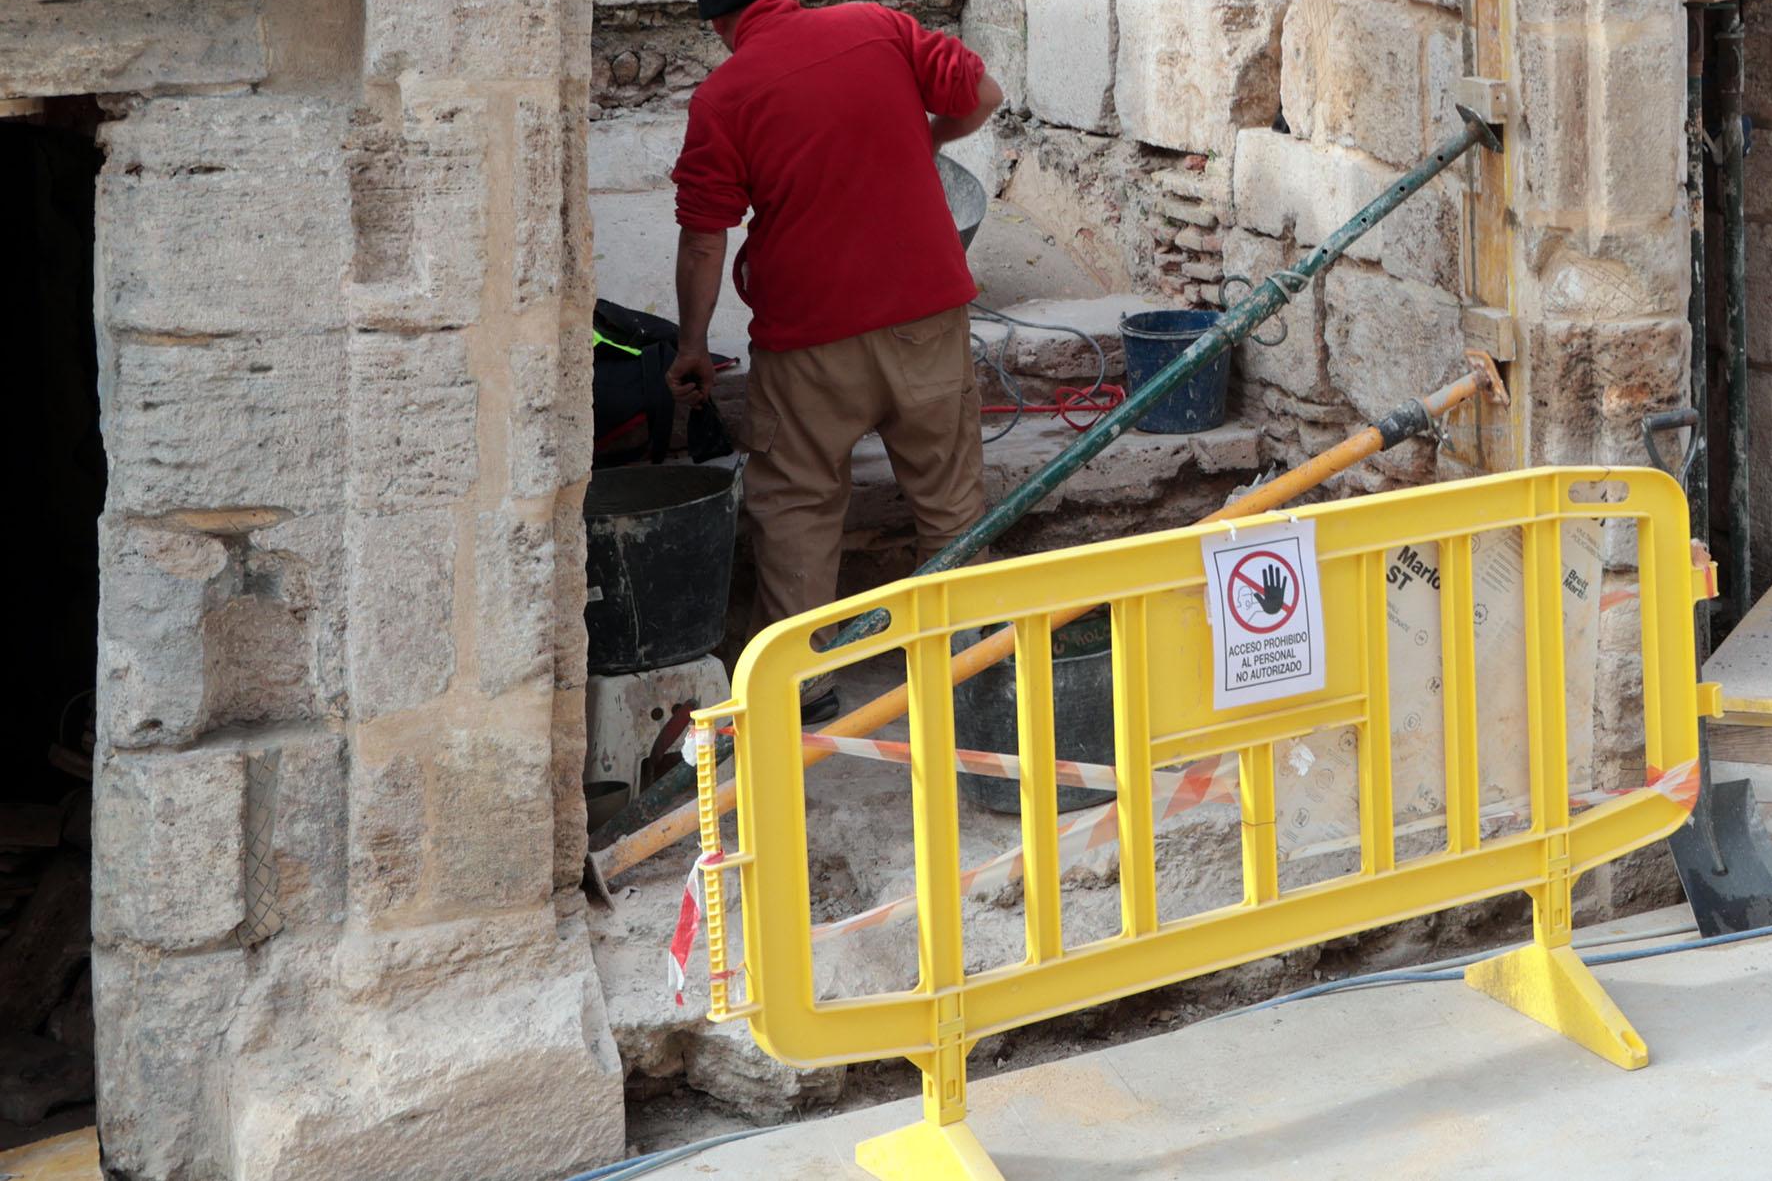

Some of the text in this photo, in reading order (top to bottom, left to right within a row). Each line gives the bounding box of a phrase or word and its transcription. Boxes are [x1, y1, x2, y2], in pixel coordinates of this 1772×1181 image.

[1397, 544, 1441, 591] Marlo
[1567, 569, 1589, 591] Brett
[1228, 631, 1308, 658] ACCESO PROHIBIDO
[1241, 648, 1297, 668] AL PERSONAL
[1236, 660, 1302, 683] NO AUTORIZADO
